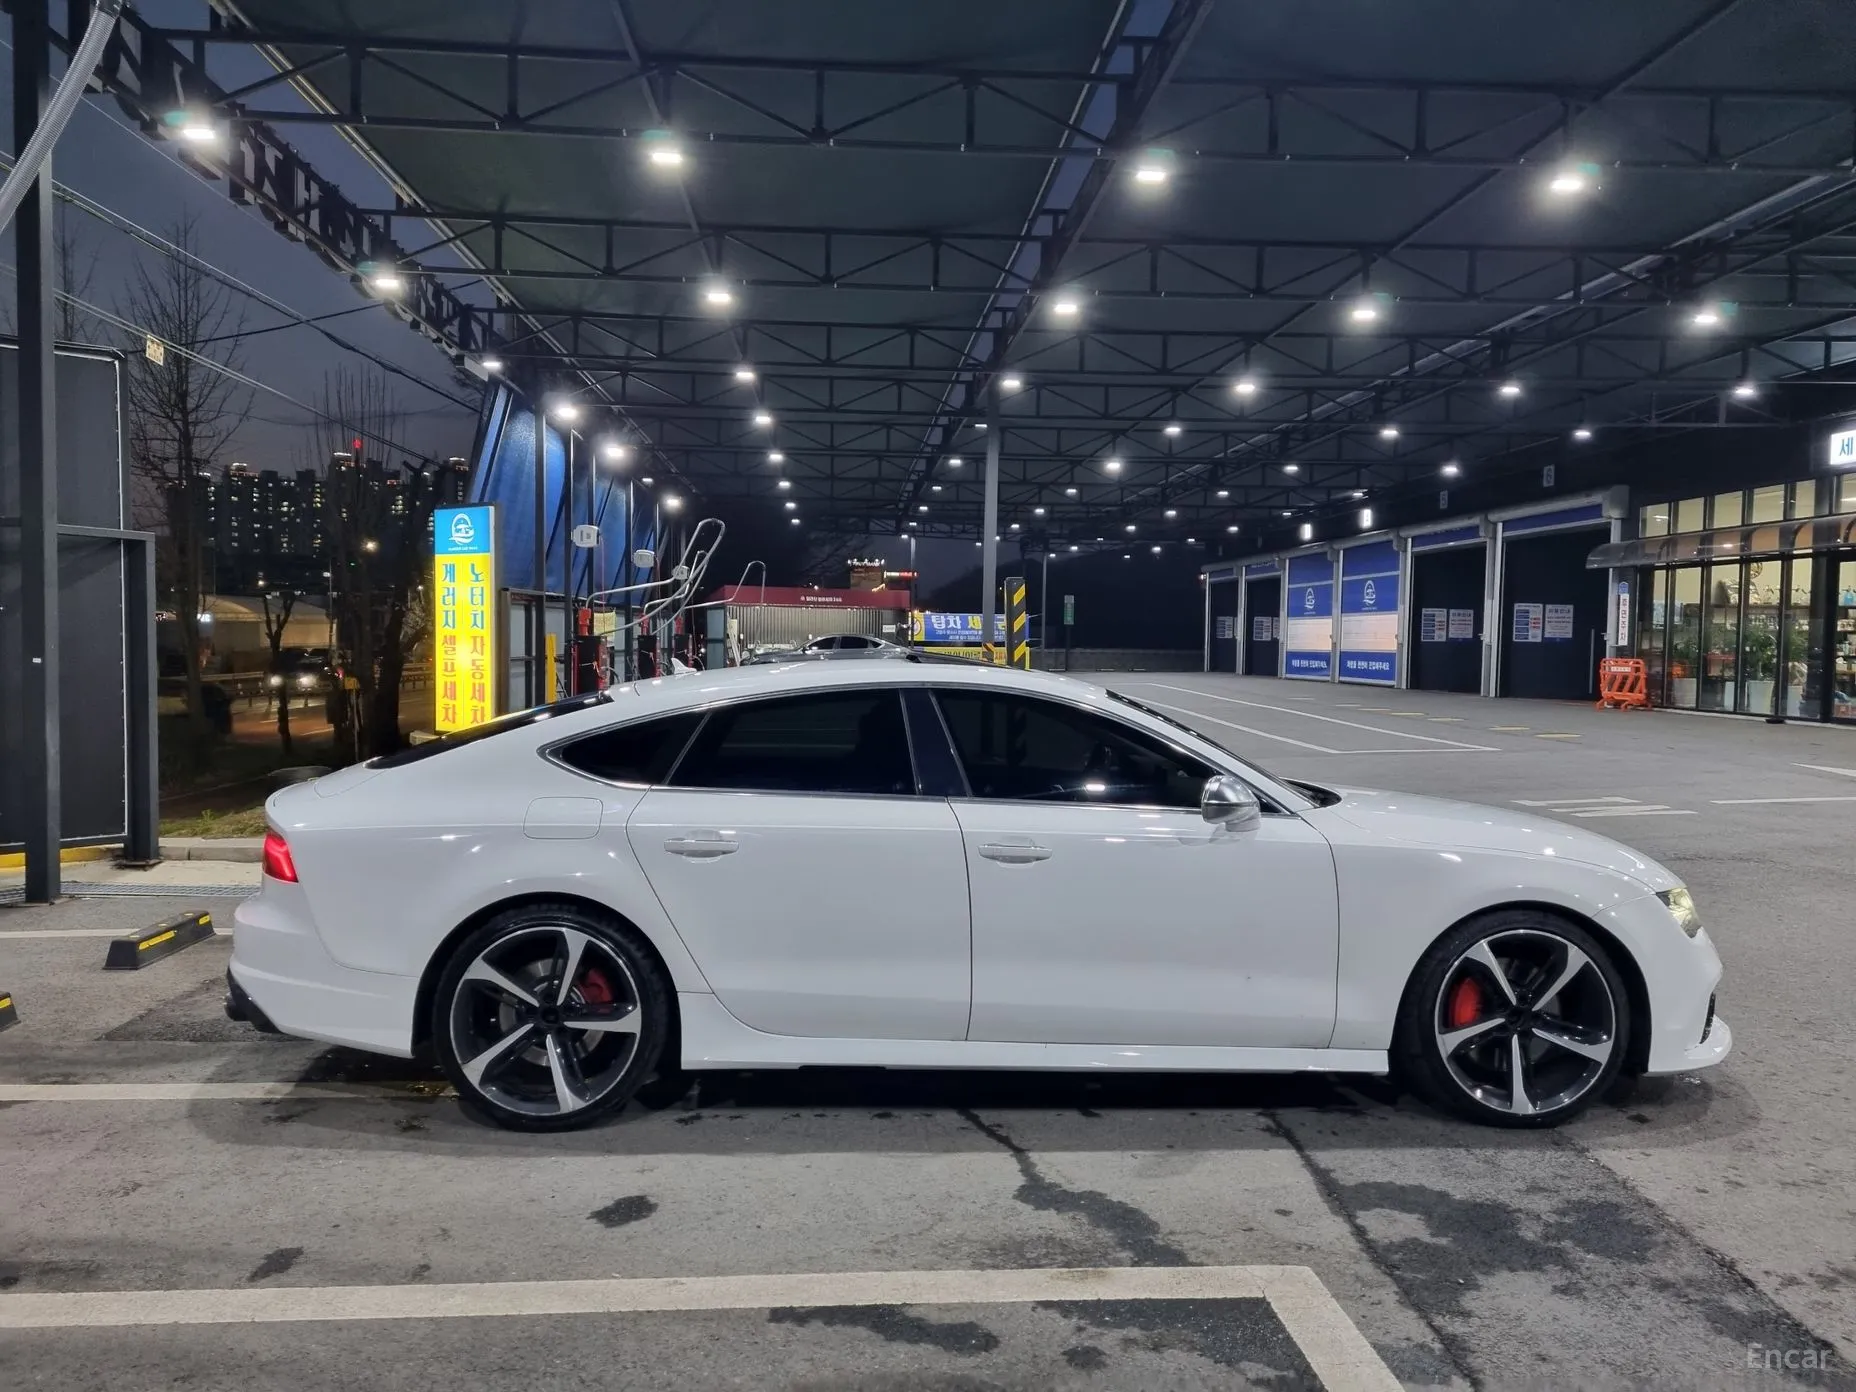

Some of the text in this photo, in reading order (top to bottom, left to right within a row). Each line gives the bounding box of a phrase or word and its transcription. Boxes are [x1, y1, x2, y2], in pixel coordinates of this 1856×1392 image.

[441, 563, 457, 725] 게러지 셀프세차
[470, 563, 486, 725] 노터치 자동세차
[931, 615, 962, 629] 탑차
